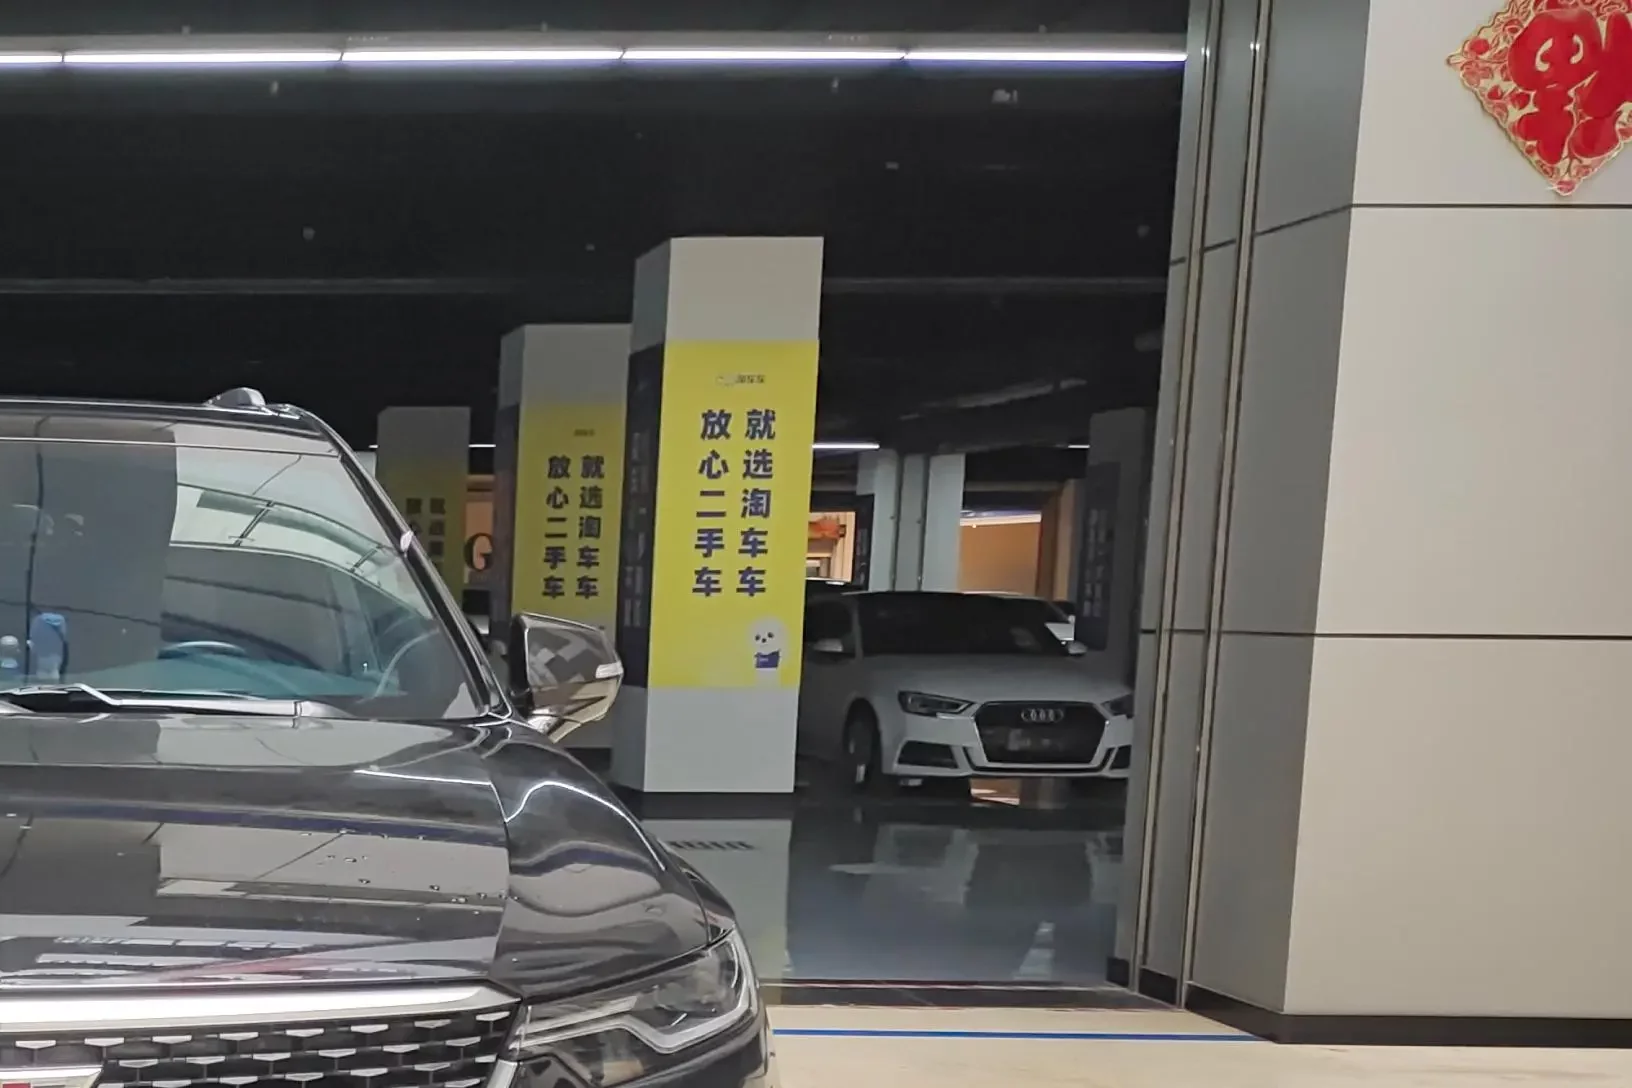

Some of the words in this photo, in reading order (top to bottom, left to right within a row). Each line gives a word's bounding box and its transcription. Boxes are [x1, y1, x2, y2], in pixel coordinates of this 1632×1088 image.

[542, 454, 571, 600] 放心二手车
[574, 454, 605, 600] 就选淘车车
[691, 408, 733, 598] 放心二手车
[736, 408, 777, 598] 就选淘车车
